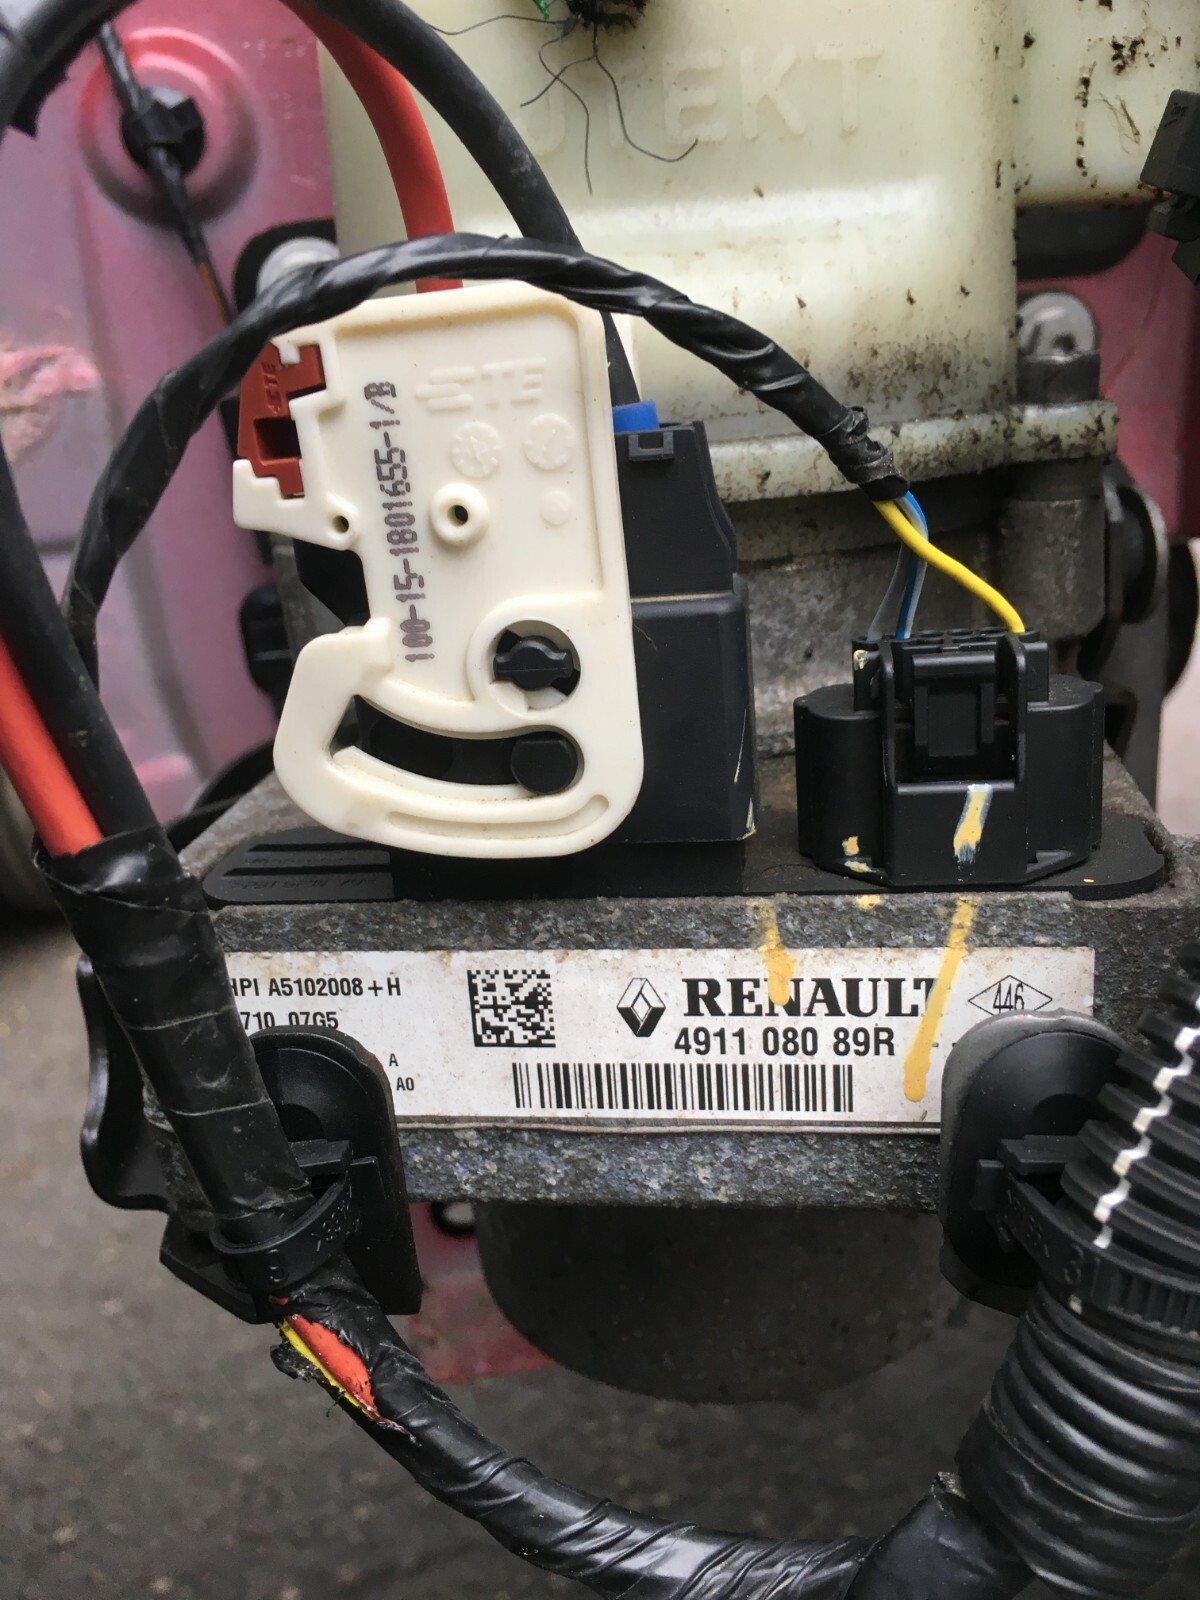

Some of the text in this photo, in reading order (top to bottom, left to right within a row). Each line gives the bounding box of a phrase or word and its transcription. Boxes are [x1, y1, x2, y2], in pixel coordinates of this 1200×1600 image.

[675, 1025, 896, 1057] 4911 080 89R
[389, 1053, 399, 1067] A
